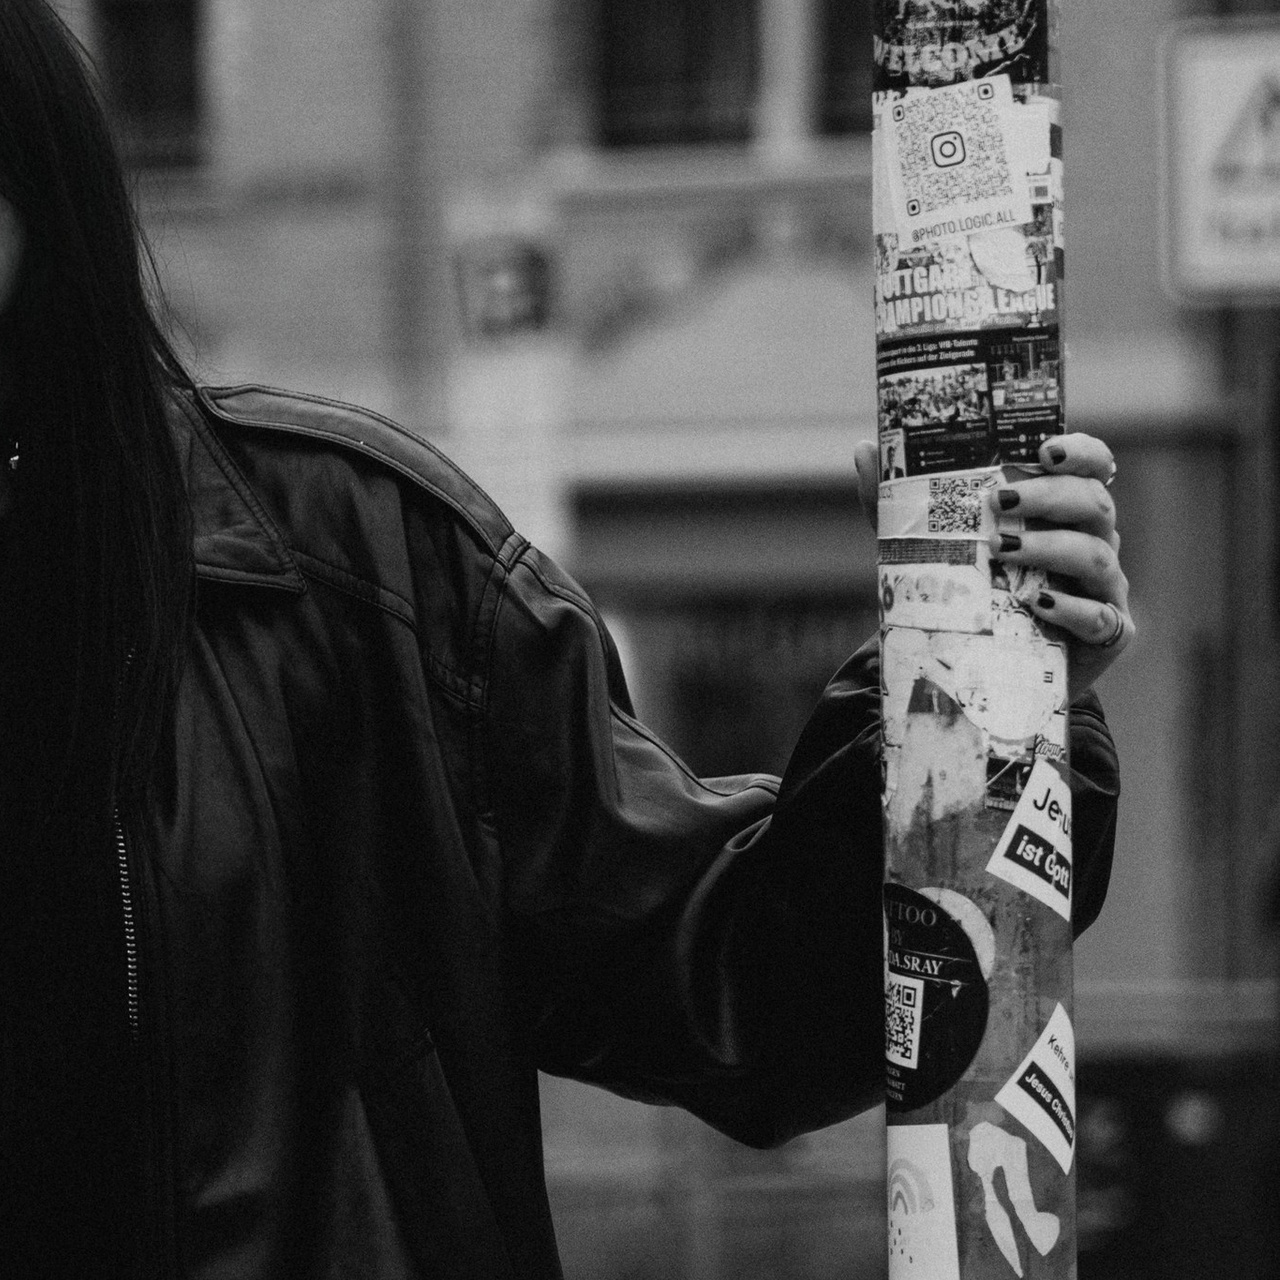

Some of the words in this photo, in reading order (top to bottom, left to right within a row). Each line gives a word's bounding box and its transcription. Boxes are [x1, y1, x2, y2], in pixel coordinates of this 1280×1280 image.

[1015, 834, 1045, 867] ist
[1047, 1033, 1070, 1072] Kehre
[1024, 1072, 1054, 1103] Jesus
